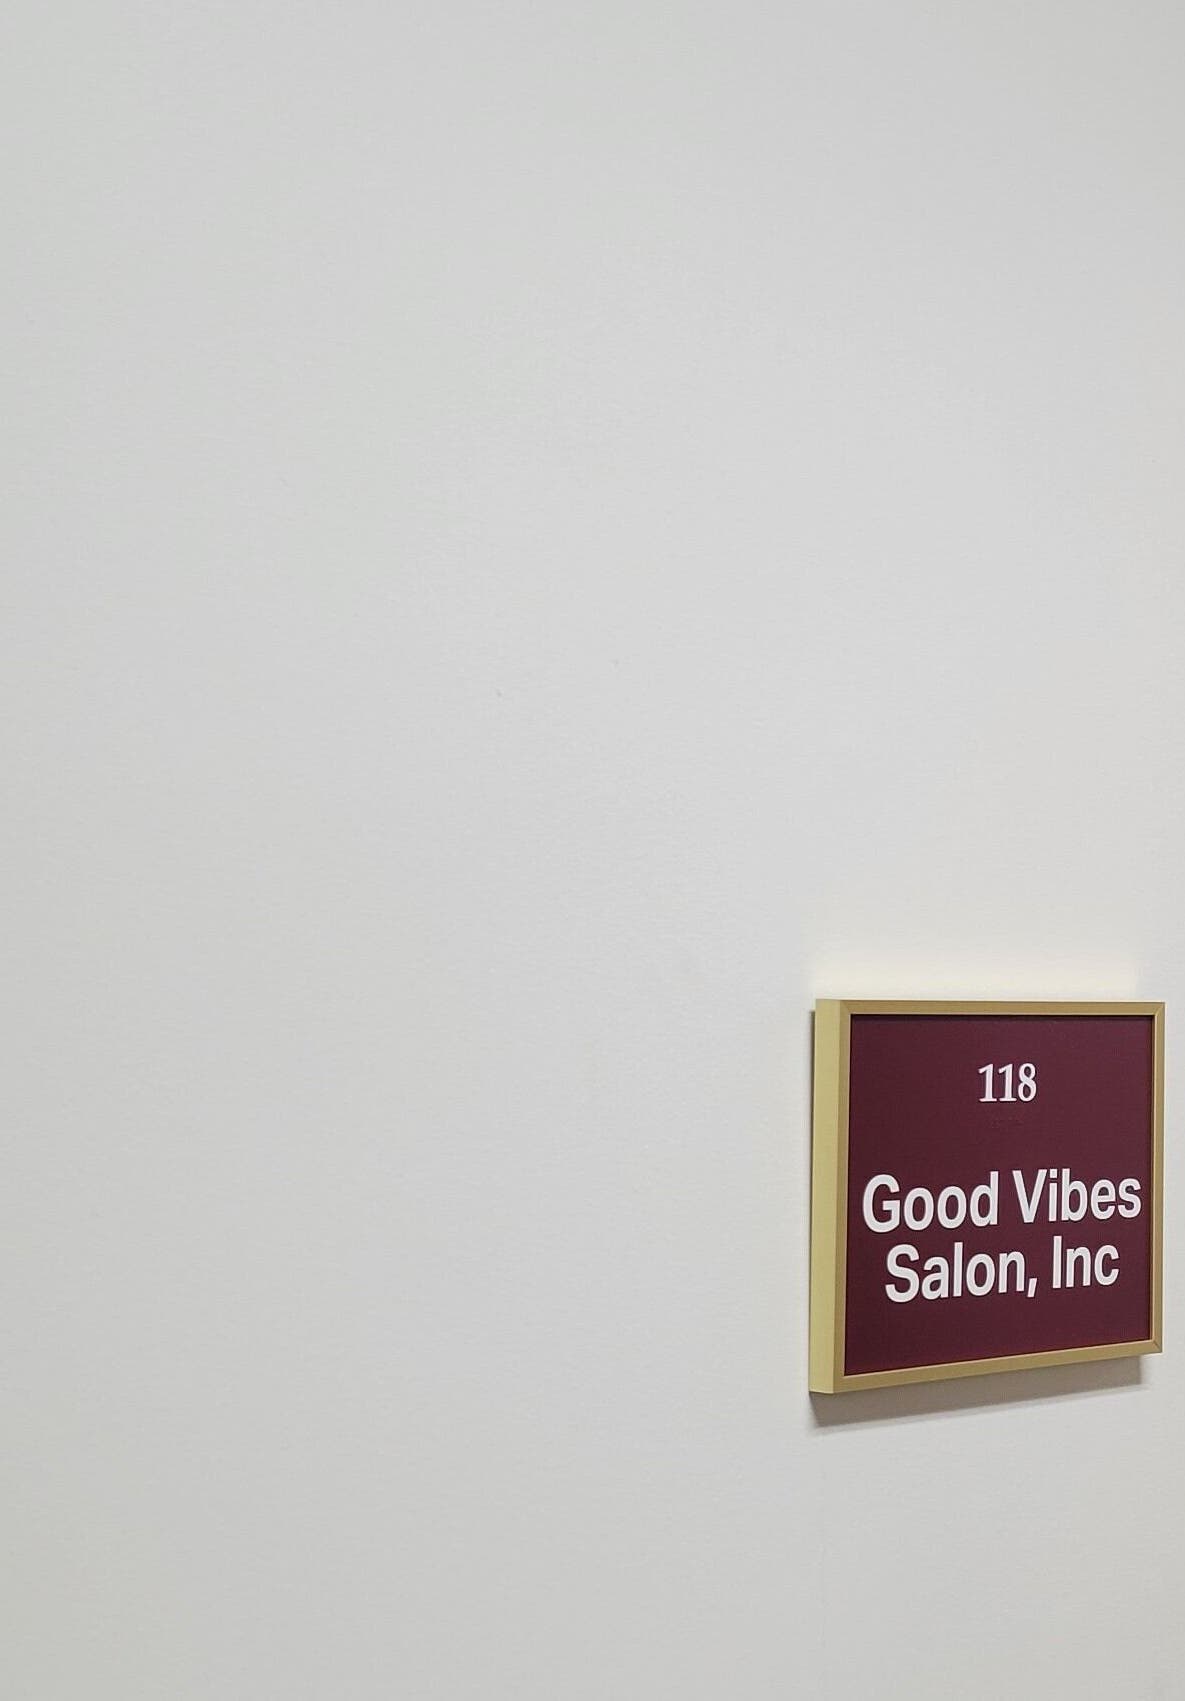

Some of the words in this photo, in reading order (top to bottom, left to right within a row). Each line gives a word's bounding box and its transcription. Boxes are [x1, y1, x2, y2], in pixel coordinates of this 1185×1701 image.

[978, 1062, 1037, 1103] 118
[862, 1170, 999, 1233] Good
[1012, 1168, 1142, 1223] Vibes
[885, 1242, 1038, 1303] Salon,
[1052, 1235, 1119, 1289] Inc
